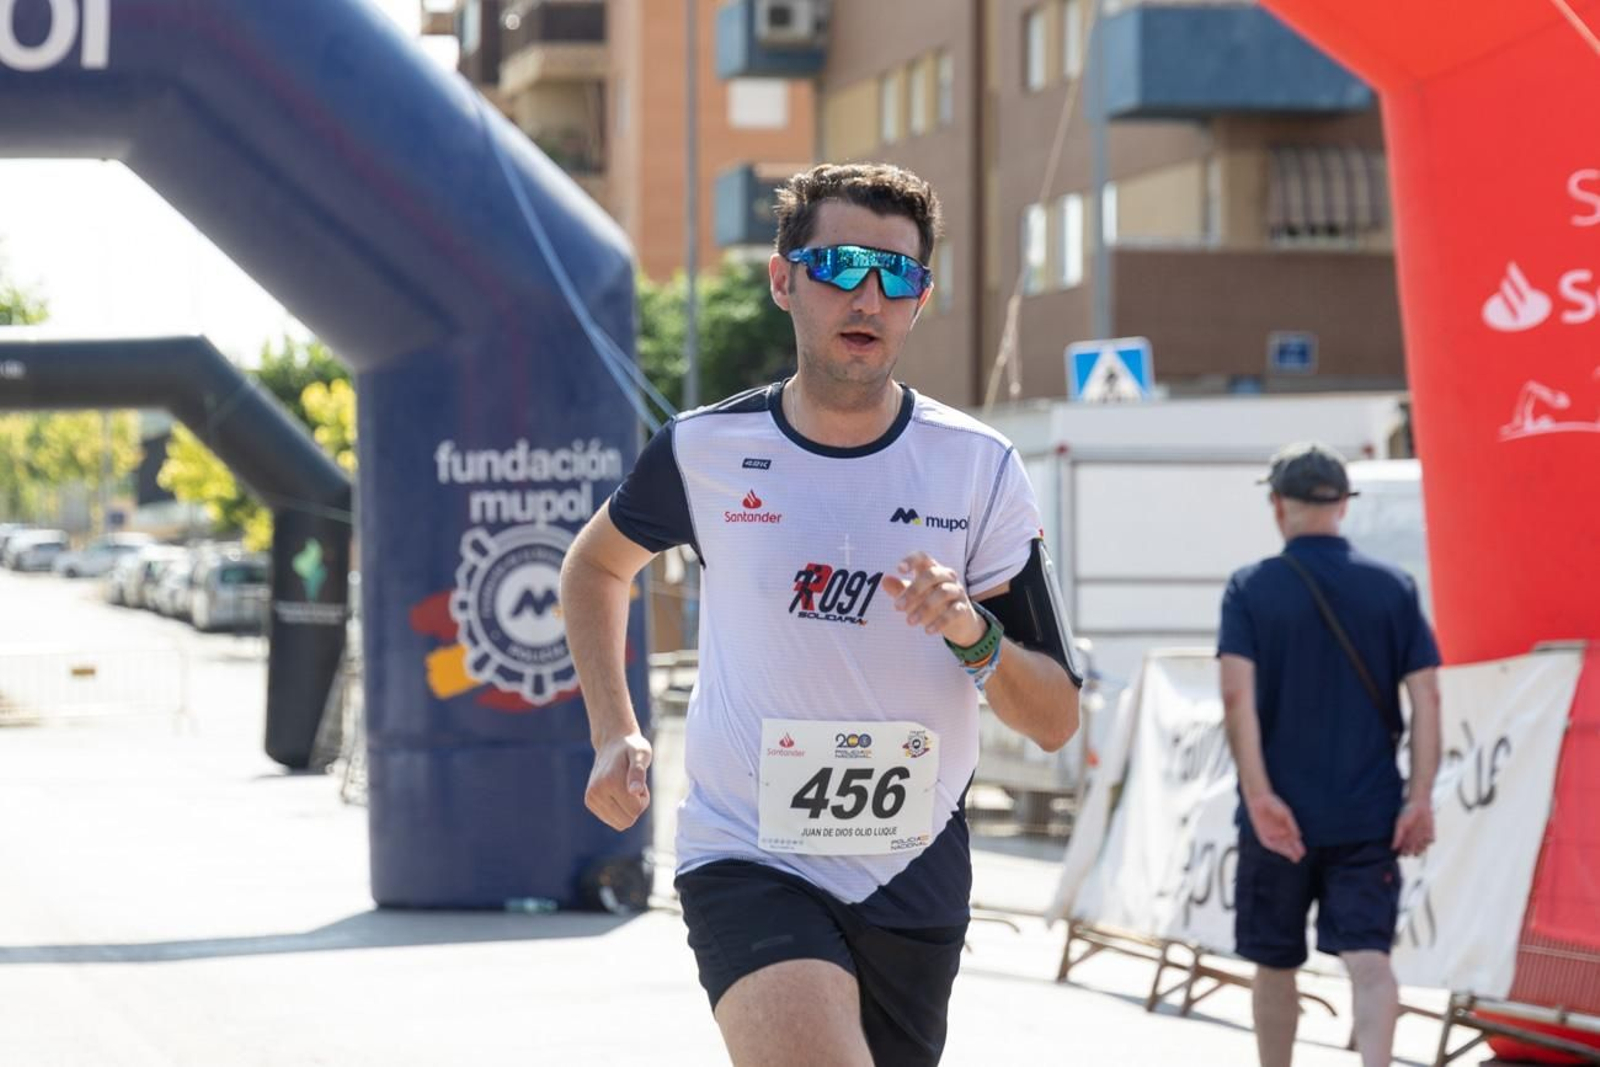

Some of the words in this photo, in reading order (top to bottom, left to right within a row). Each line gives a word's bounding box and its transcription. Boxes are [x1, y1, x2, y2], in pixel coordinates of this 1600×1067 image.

[435, 438, 621, 484] fundación
[469, 483, 593, 530] mupol
[724, 511, 782, 523] Santander
[767, 748, 806, 757] Santander
[790, 766, 910, 820] 456
[801, 827, 821, 838] JUAN
[822, 827, 834, 838] DE
[835, 827, 853, 838] DIOS
[854, 827, 872, 837] OLID
[874, 826, 897, 837] LUQUE
